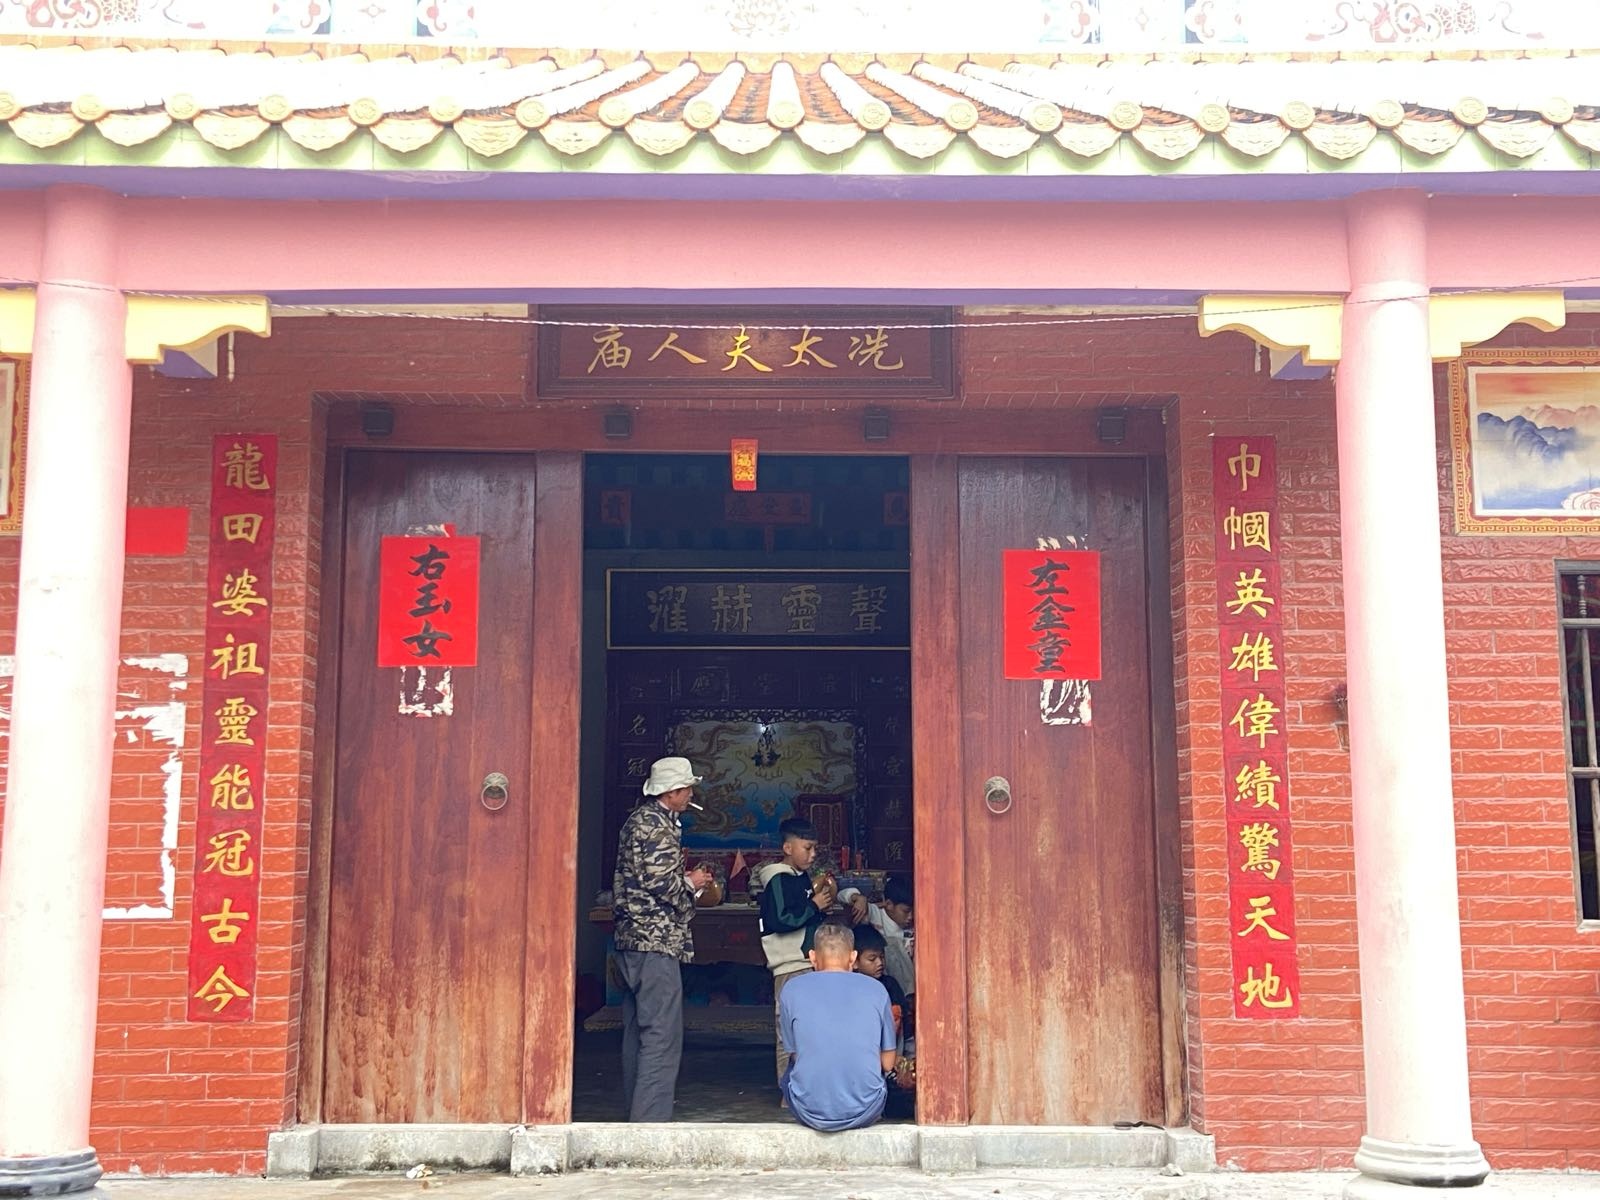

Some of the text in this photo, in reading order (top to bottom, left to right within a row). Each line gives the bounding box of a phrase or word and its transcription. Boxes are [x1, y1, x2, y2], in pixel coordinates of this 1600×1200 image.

[194, 443, 270, 1013] 龍田婆祖靈能冠古今
[402, 544, 453, 659] 右玉女
[1024, 558, 1075, 674] 左金童
[1223, 443, 1293, 1008] 巾幗英雄偉績驚天地
